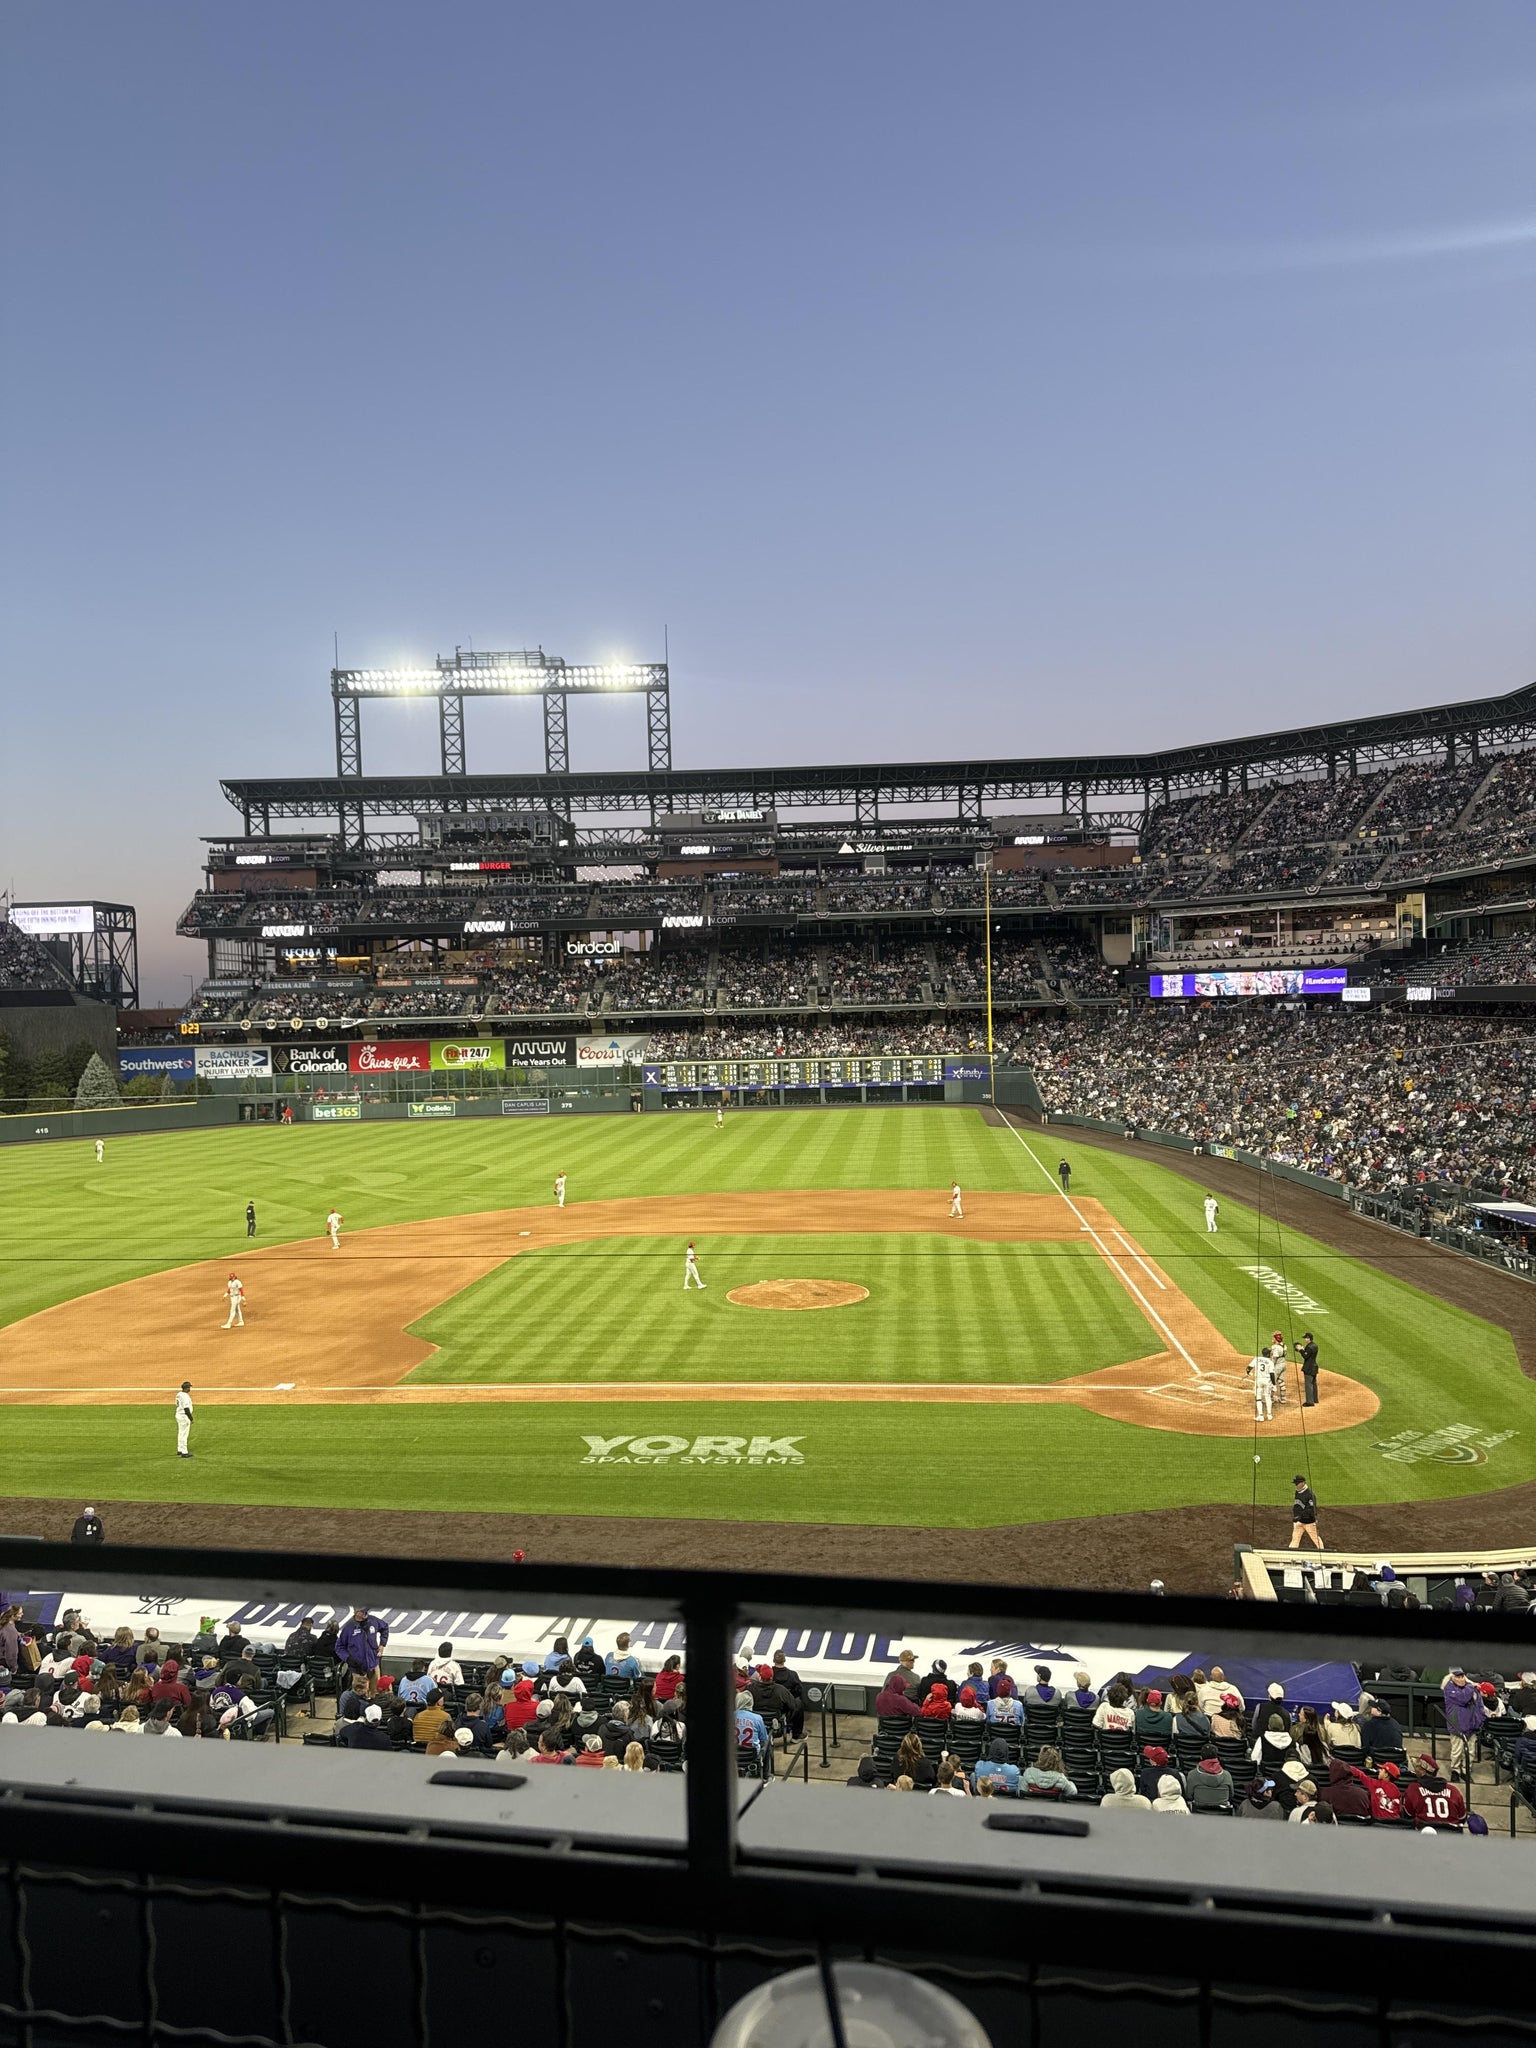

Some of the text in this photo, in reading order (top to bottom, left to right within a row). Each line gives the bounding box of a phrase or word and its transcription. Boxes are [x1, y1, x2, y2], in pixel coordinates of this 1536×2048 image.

[718, 810, 736, 820] JACK
[737, 810, 763, 820] DANIEL'S
[464, 816, 548, 832] ROOFTOP
[856, 842, 886, 852] Silver
[464, 921, 505, 932] ARROW
[662, 916, 704, 927] ARROW
[262, 925, 305, 937] ARROW
[567, 940, 620, 954] birdcall
[181, 1023, 199, 1034] 0:23
[290, 1047, 335, 1060] Bank of
[446, 1048, 489, 1058] Fix-it 24/7
[512, 1042, 566, 1055] ARROW
[579, 1047, 614, 1060] Coors
[210, 1051, 249, 1059] BACHUS
[120, 1058, 184, 1072] Southwest
[198, 1059, 250, 1068] SCHANKER
[290, 1060, 347, 1072] Colorado
[646, 1072, 657, 1083] X
[952, 1067, 983, 1079] xfinity
[315, 1107, 359, 1118] bet365
[580, 1435, 807, 1456] YORK
[580, 1456, 806, 1465] SPACE SYSTEMS
[1106, 1714, 1128, 1726] MARSH
[1425, 1797, 1449, 1818] 10
